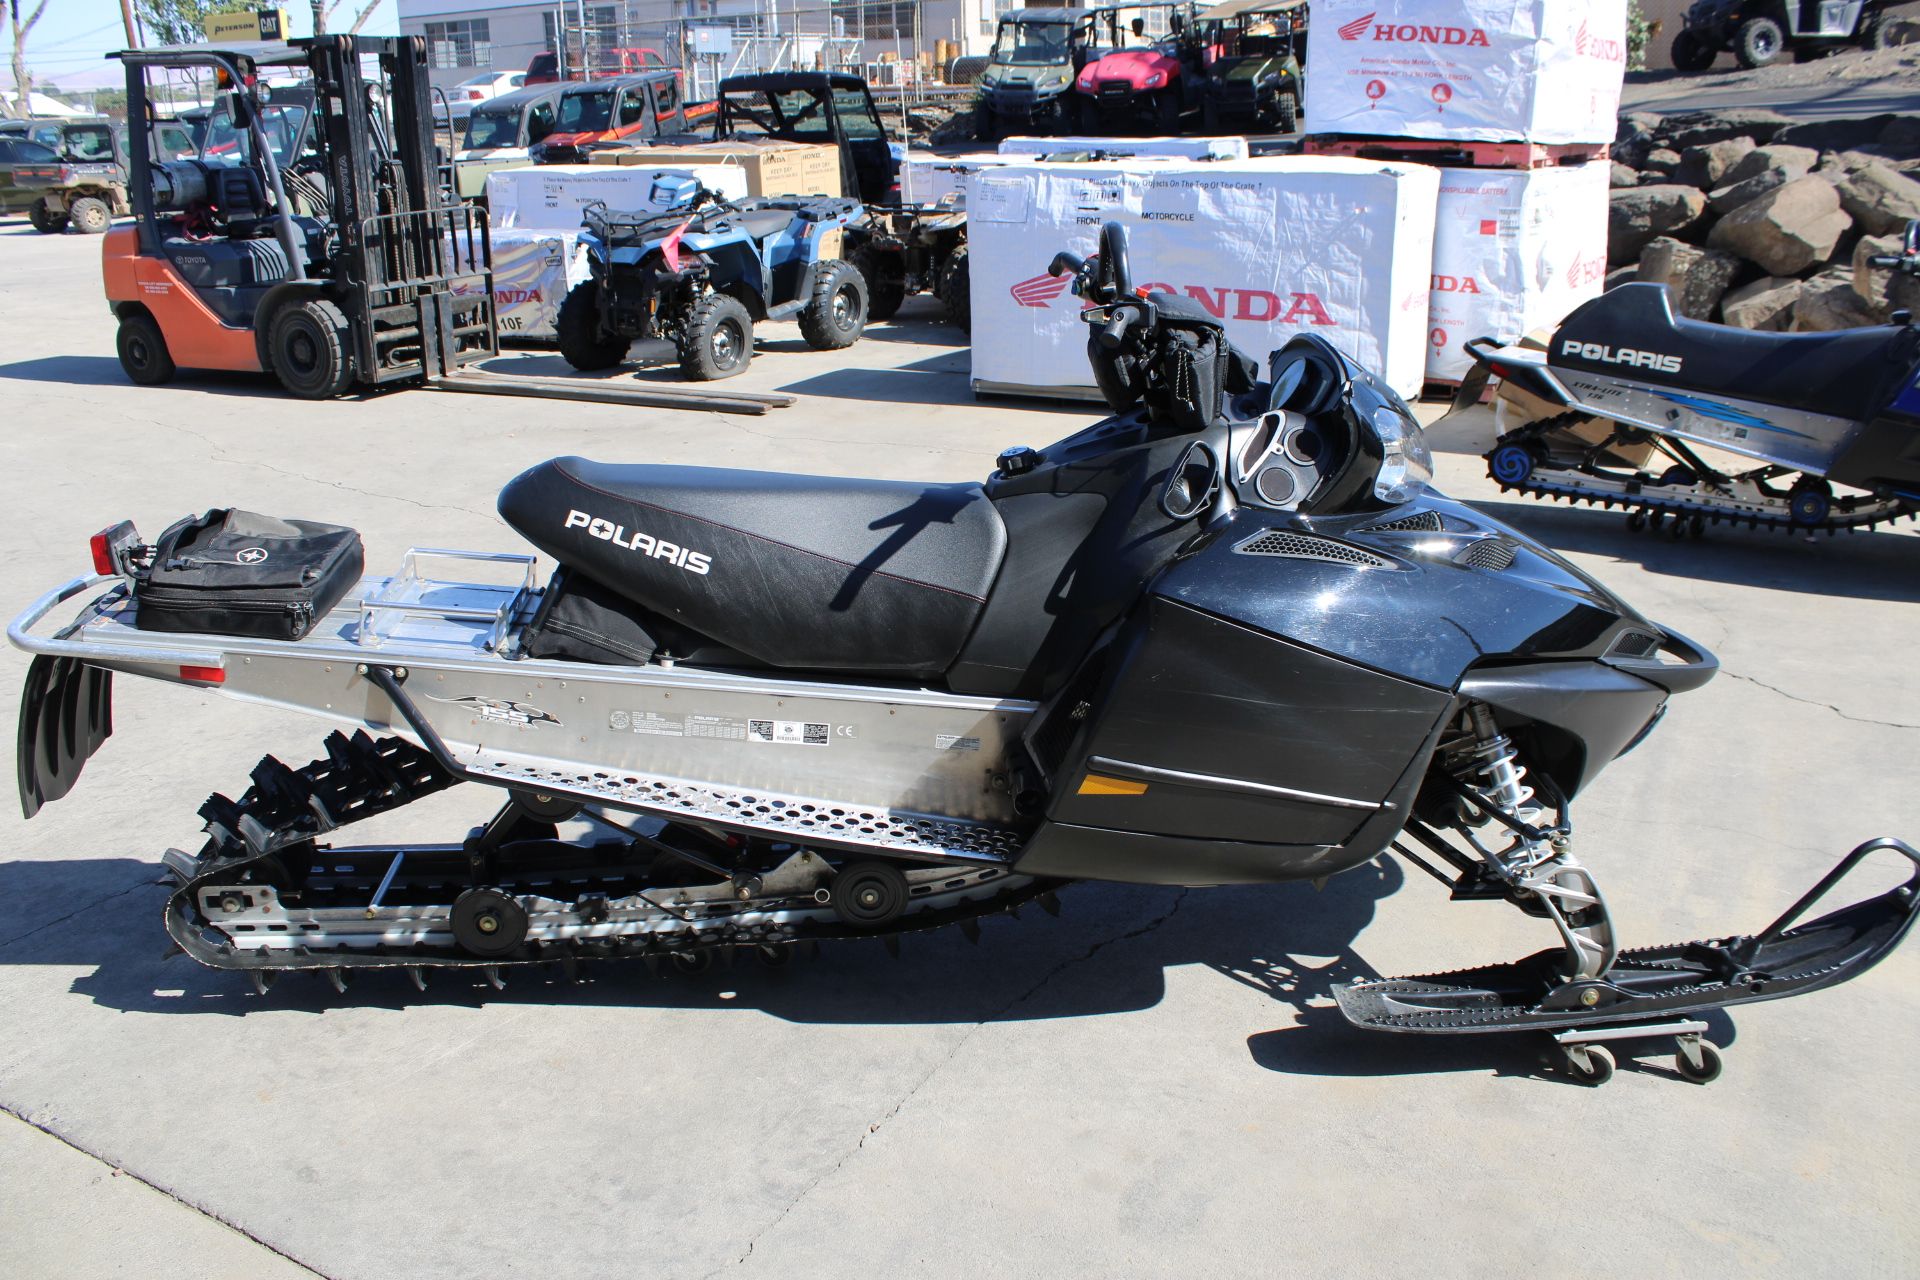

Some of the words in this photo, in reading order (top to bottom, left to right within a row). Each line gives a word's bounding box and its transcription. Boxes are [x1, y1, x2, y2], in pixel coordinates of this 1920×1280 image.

[215, 24, 254, 34] PETERSON
[260, 17, 277, 32] CAT
[1373, 24, 1491, 47] HONDA
[339, 155, 352, 215] TOYOTA
[1089, 178, 1107, 186] Place
[1170, 180, 1179, 188] On
[1182, 180, 1194, 188] The
[1195, 180, 1209, 189] Top
[1210, 181, 1219, 189] Of
[1221, 181, 1234, 189] The
[1235, 182, 1255, 190] Crate
[1482, 187, 1508, 195] BATTERY
[1076, 217, 1101, 225] FRONT
[1141, 212, 1194, 221] MOTORCYCLE
[184, 256, 206, 264] TOYOTA
[1081, 283, 1338, 326] NDA
[1562, 340, 1683, 373] POLARIS
[1573, 381, 1625, 397] XTRA-LITE
[564, 509, 712, 575] POLARIS
[480, 705, 529, 724] 155
[836, 725, 853, 737] CE
